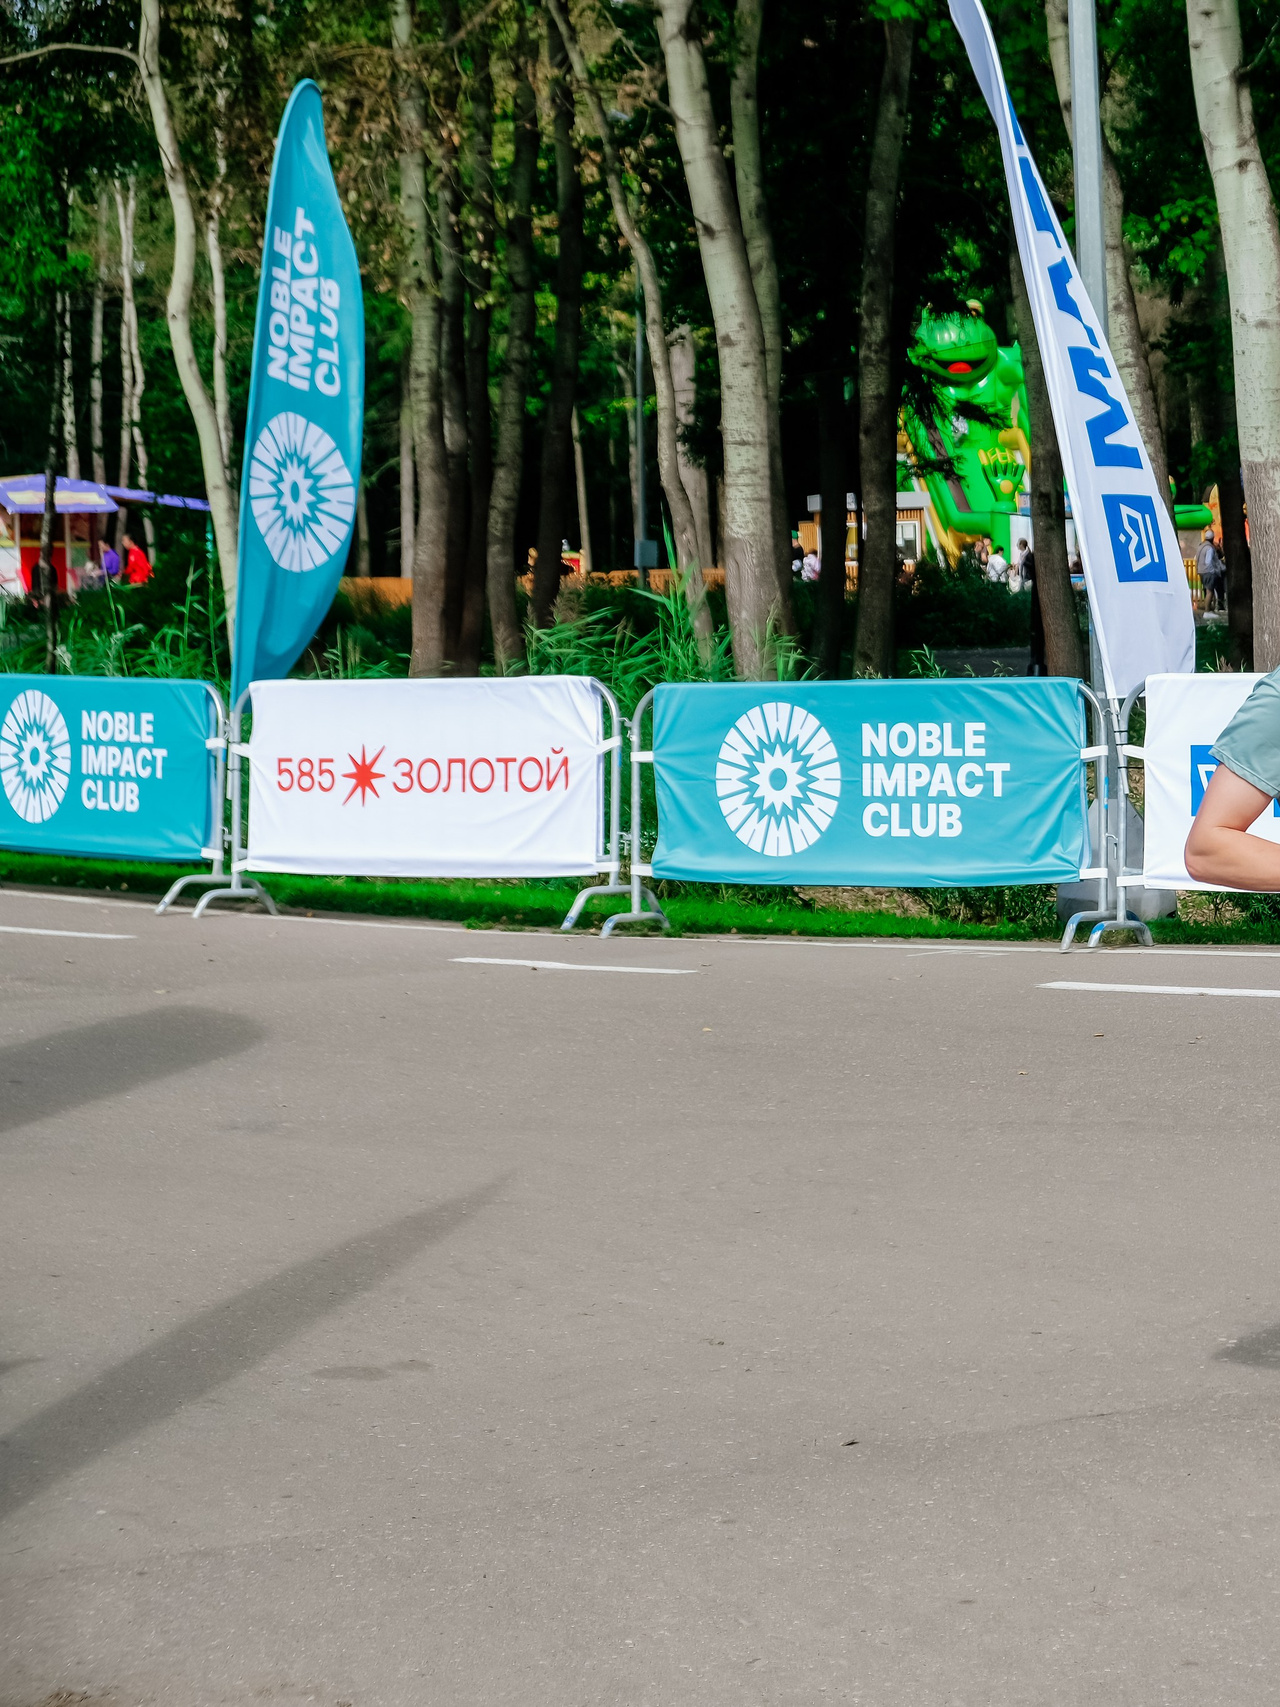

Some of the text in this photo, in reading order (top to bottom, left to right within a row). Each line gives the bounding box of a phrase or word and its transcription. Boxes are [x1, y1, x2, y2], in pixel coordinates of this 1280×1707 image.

[267, 226, 292, 383] NOBLE
[287, 206, 320, 393] IMPACT
[314, 276, 341, 397] CLUB
[81, 710, 154, 743] NOBLE
[861, 722, 987, 758] NOBLE
[81, 745, 168, 779] IMPACT
[277, 747, 570, 794] 585 ЗОЛОТОЙ
[862, 762, 1011, 798] IMPACT
[81, 779, 140, 812] CLUB
[862, 802, 963, 838] CLUB
